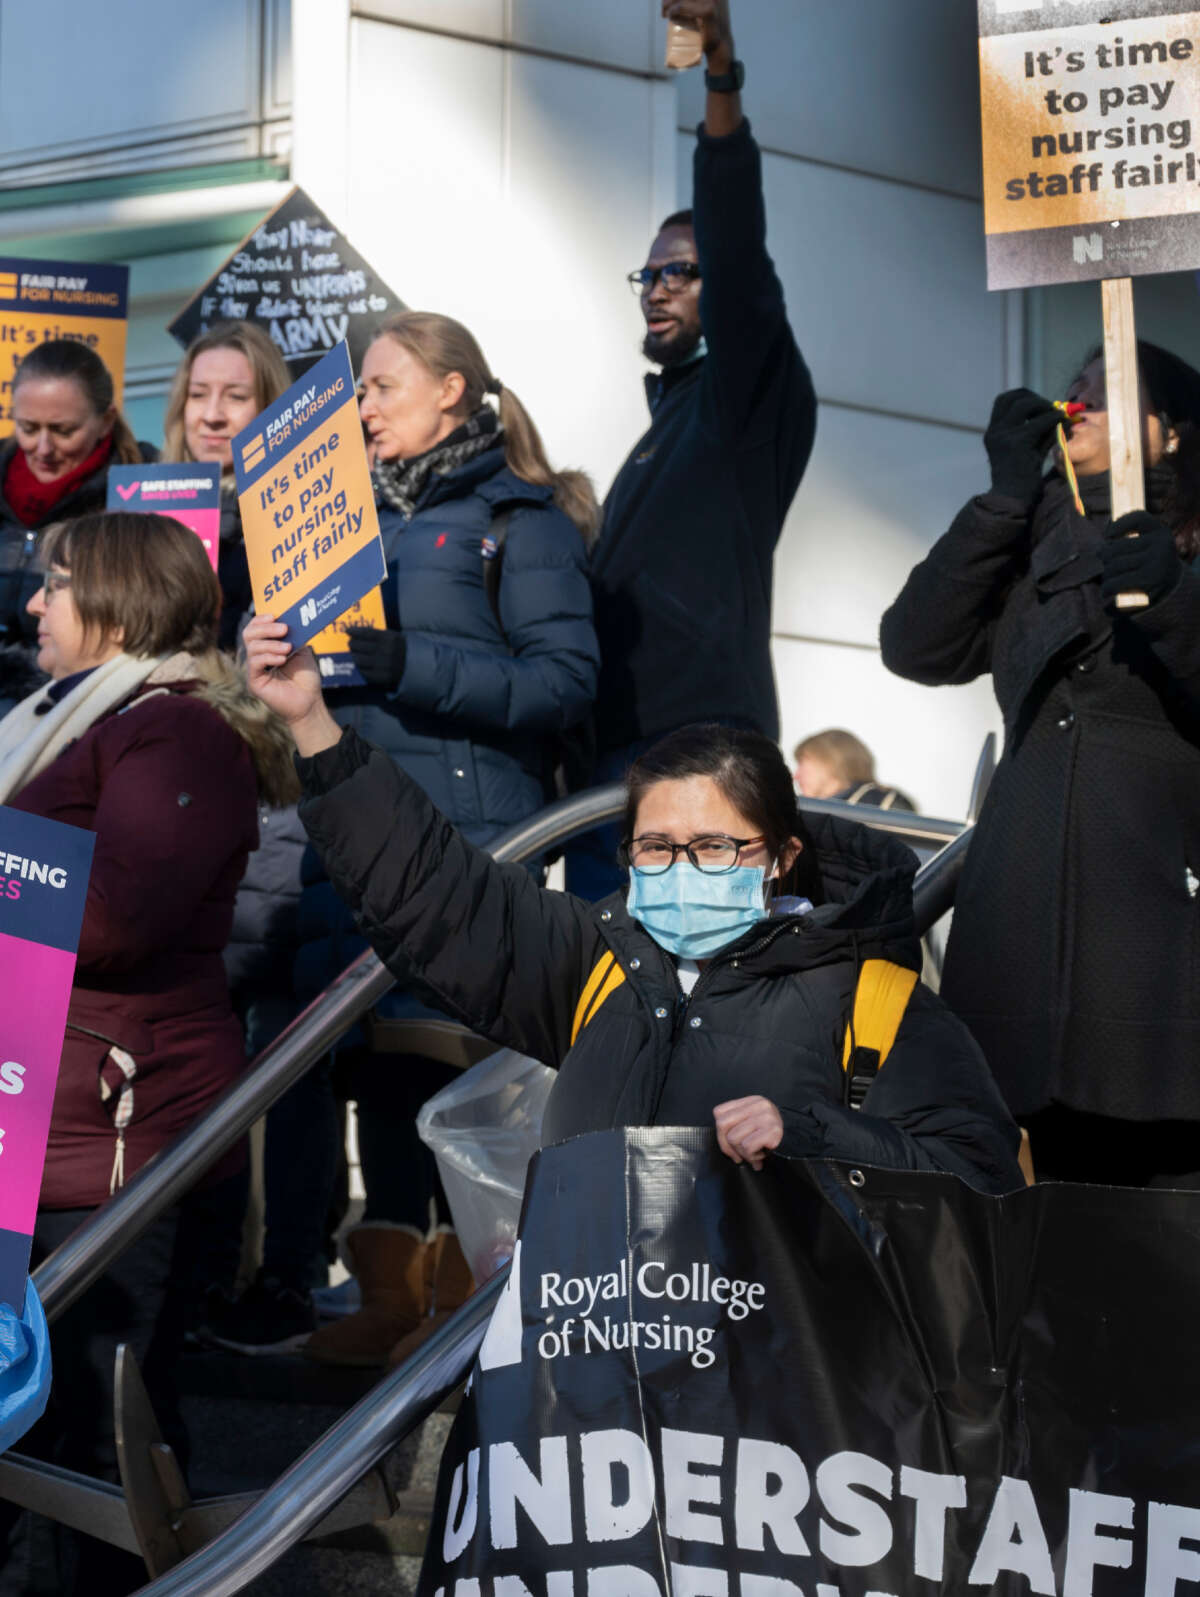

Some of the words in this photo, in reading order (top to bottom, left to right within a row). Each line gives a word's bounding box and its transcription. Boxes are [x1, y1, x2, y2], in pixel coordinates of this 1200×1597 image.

[1024, 47, 1085, 78] It's
[1096, 36, 1194, 69] time
[1044, 90, 1088, 115] to
[1100, 80, 1175, 116] pay
[1032, 116, 1192, 158] nursing
[1005, 161, 1103, 201] staff
[1112, 152, 1200, 190] fairl
[1, 325, 36, 344] It's
[270, 314, 348, 353] ARMY
[266, 408, 292, 438] FAIR
[294, 385, 316, 414] PAY
[268, 424, 291, 451] FOR
[293, 377, 344, 430] NURSING
[260, 475, 290, 510] It's
[294, 433, 339, 480] time
[273, 508, 293, 528] to
[300, 467, 334, 517] pay
[271, 489, 347, 563] nursing
[263, 550, 307, 602] staff
[312, 506, 364, 562] fairly
[539, 1258, 627, 1318] Royal
[636, 1261, 766, 1320] College
[537, 1315, 574, 1359] of
[582, 1315, 716, 1369] Nursing
